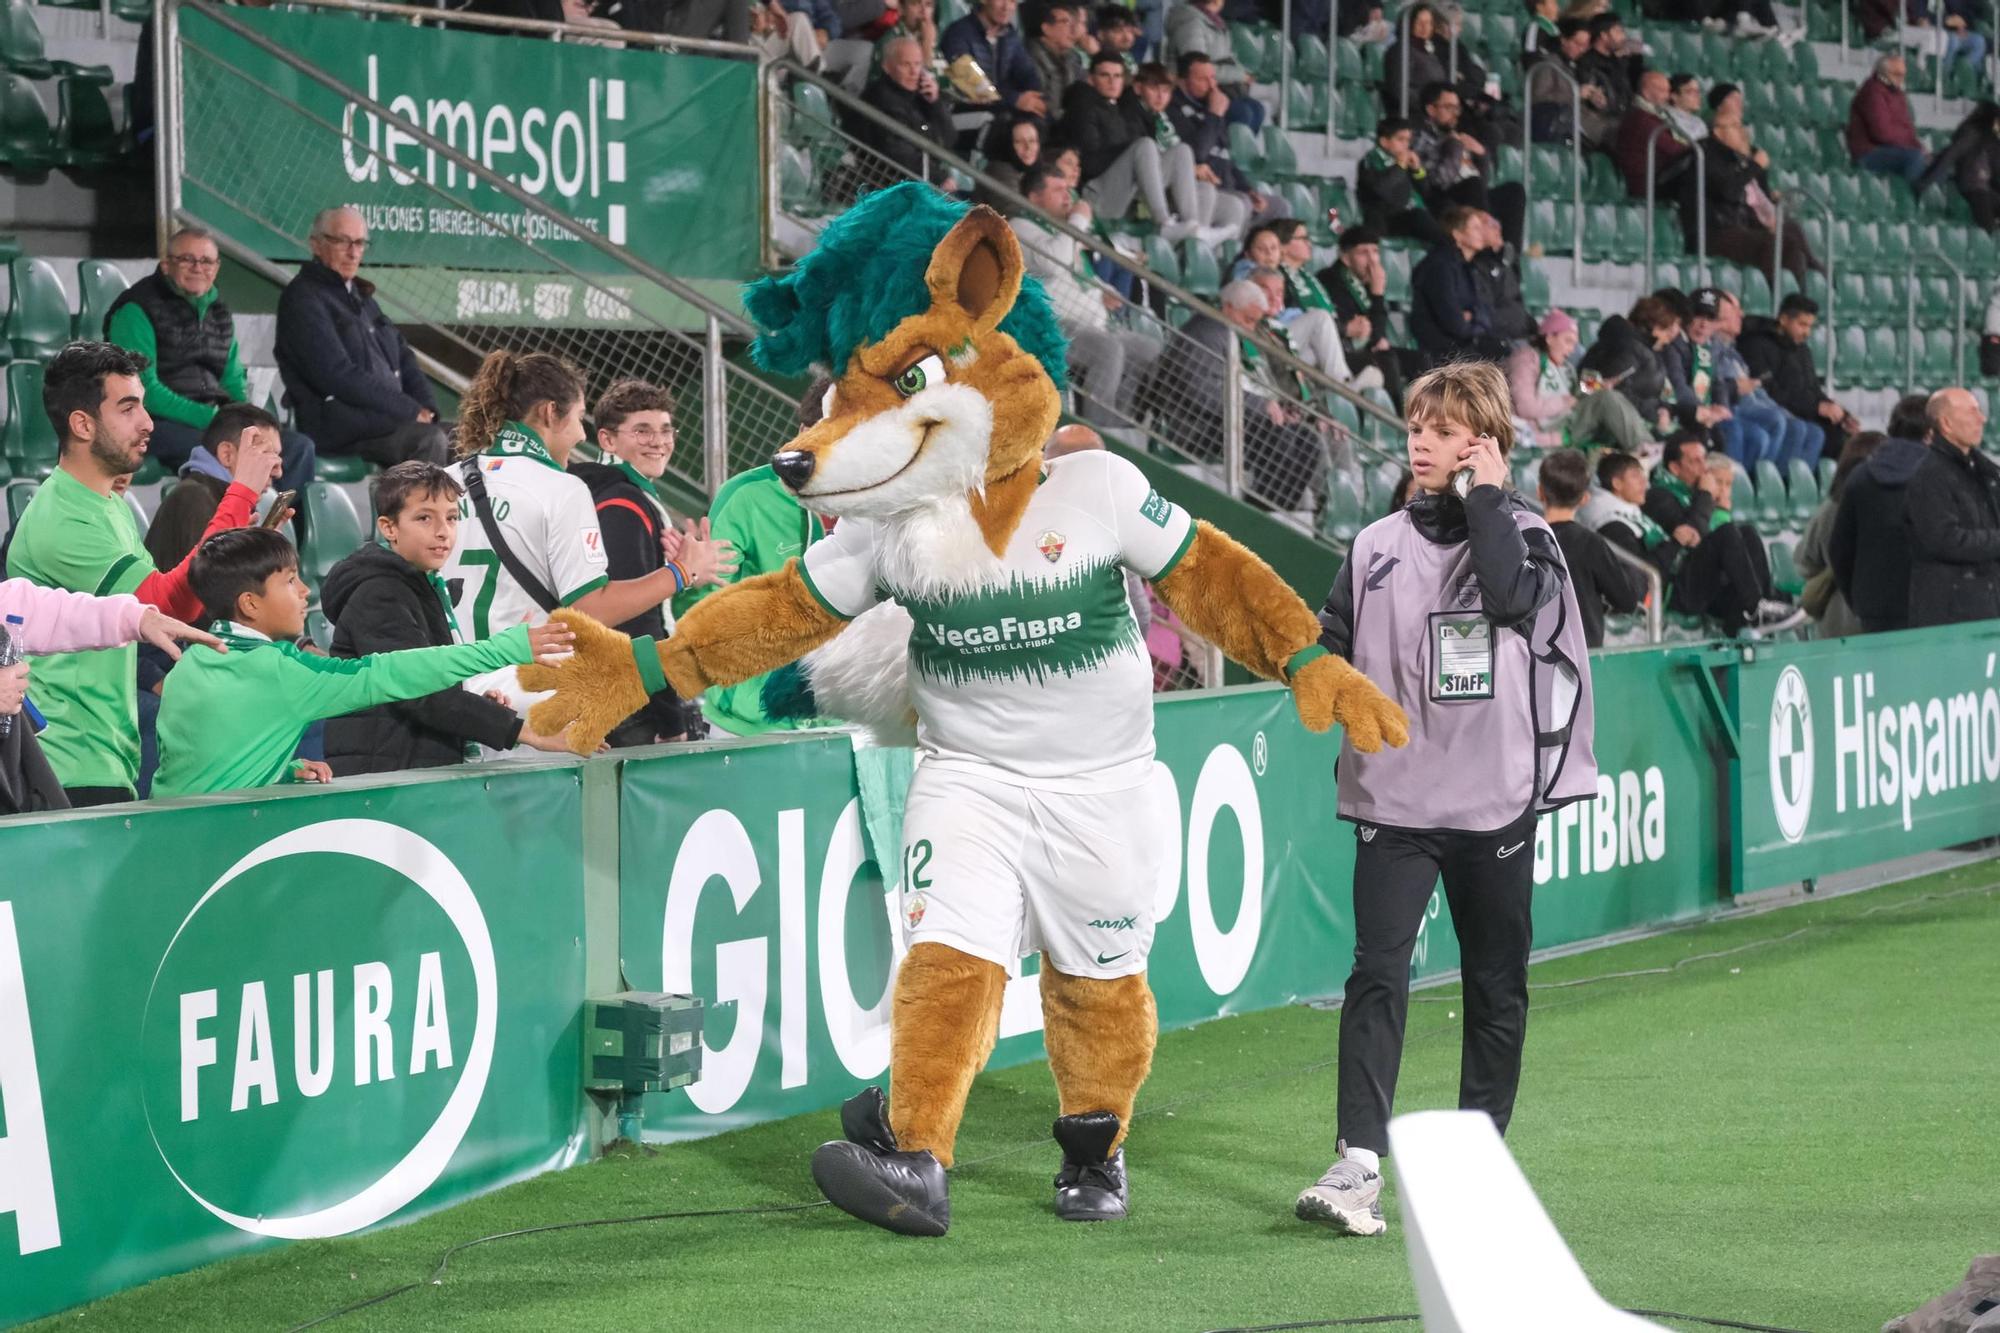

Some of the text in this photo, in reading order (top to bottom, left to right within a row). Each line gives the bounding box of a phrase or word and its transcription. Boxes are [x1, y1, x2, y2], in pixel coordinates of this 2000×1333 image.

[342, 54, 600, 198] demesol
[458, 549, 501, 641] 7
[960, 647, 973, 655] EL
[973, 645, 992, 654] REY
[1009, 641, 1023, 650] LA
[1025, 637, 1056, 649] FIBRA
[1445, 674, 1485, 692] STAFF
[1833, 652, 2000, 832] Hispamó
[904, 839, 933, 893] 12
[180, 951, 454, 1123] FAURA
